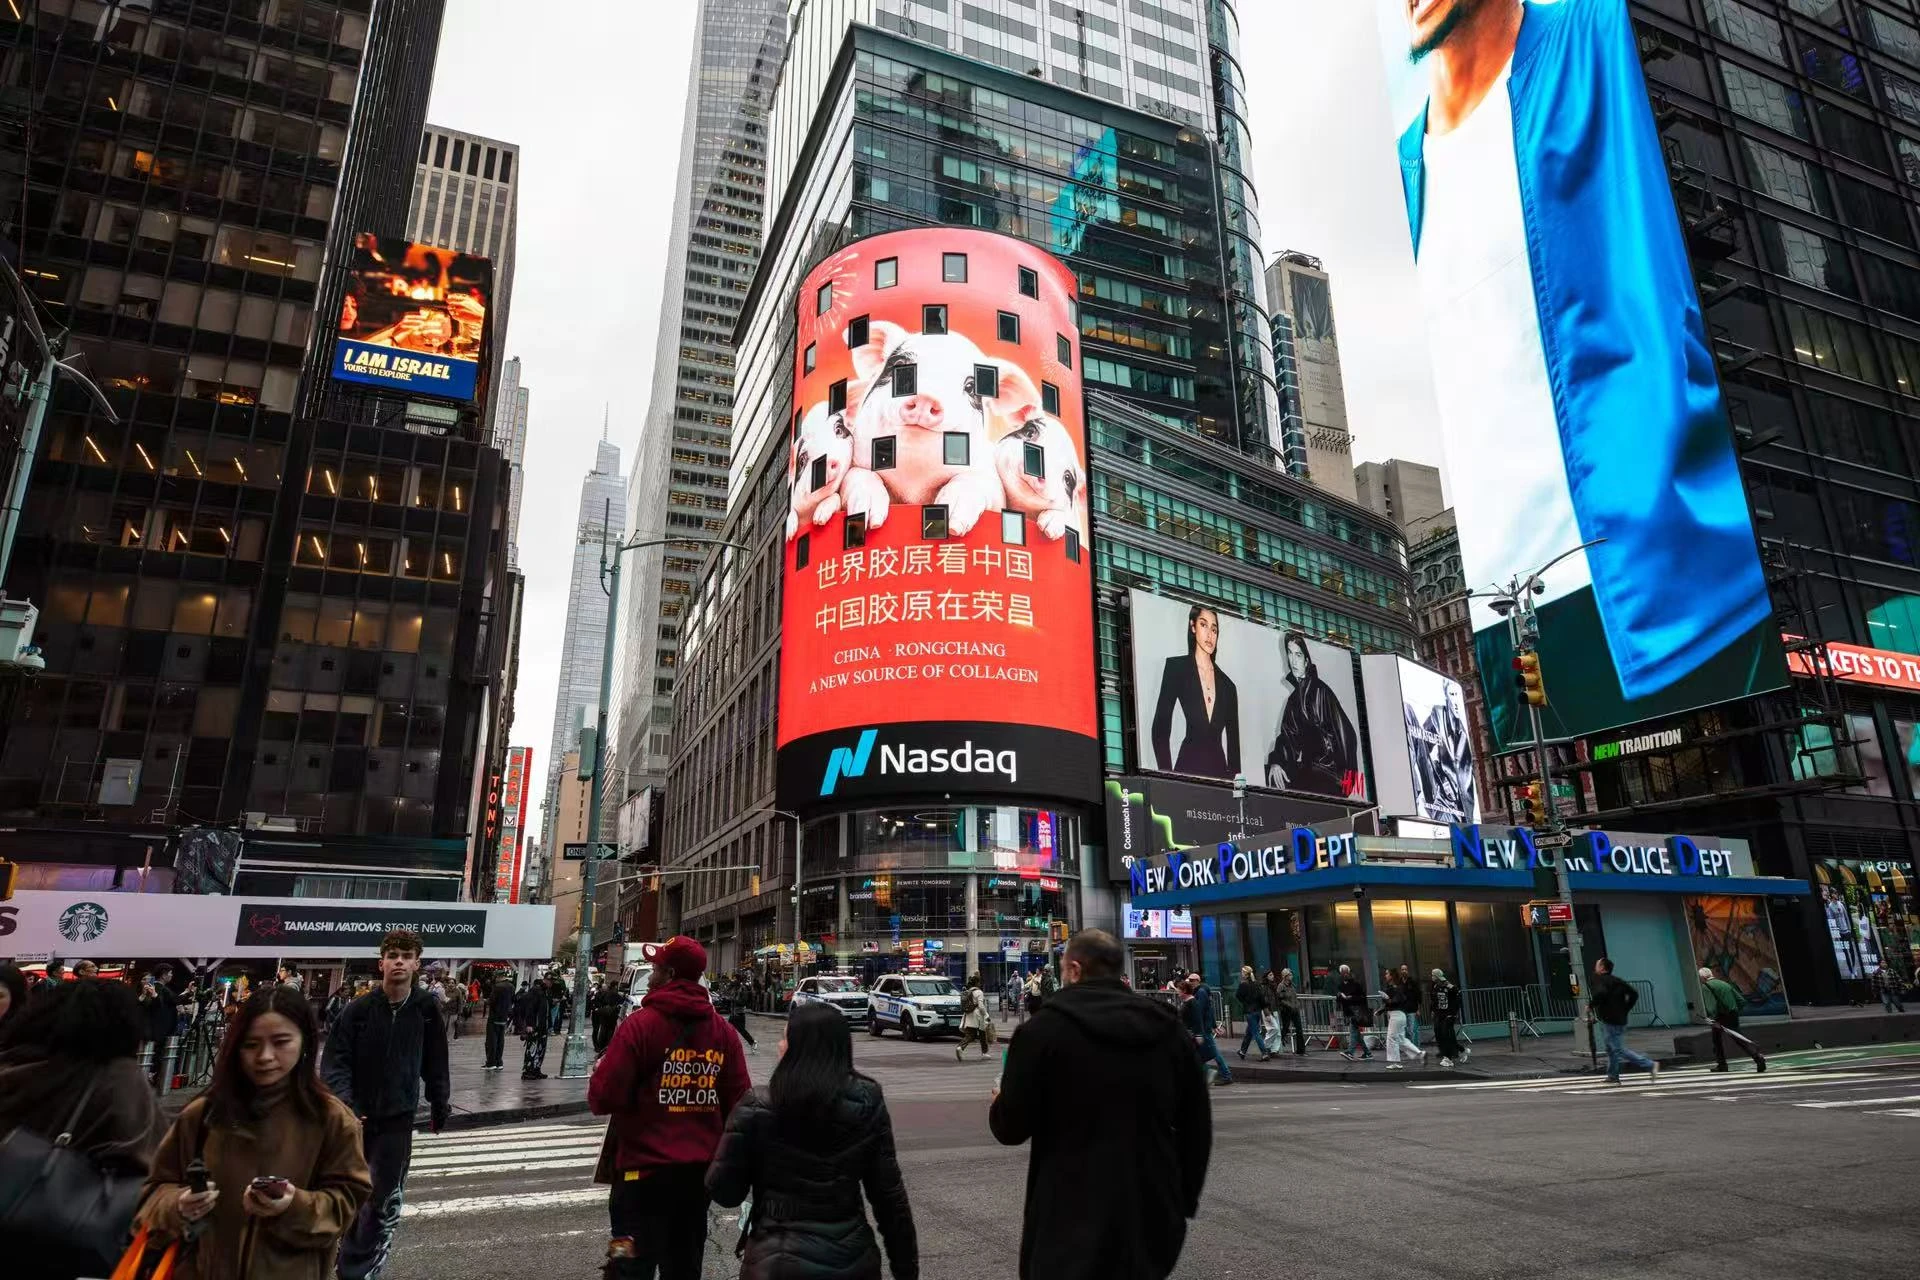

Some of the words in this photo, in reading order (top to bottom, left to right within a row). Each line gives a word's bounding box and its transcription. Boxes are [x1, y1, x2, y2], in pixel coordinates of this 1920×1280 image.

[344, 348, 353, 362] I
[355, 351, 388, 368] AM
[392, 356, 450, 380] ISRAEL
[344, 362, 367, 374] YOURS
[368, 367, 377, 375] TO
[379, 369, 412, 381] EXPLORE.
[816, 543, 1033, 589] 世界胶原看中国
[815, 588, 1033, 635] 中国胶原在荣昌
[834, 646, 881, 665] CHINA
[1873, 655, 1900, 679] TO
[809, 681, 818, 694] A
[820, 672, 850, 691] NEW
[853, 665, 918, 684] SOURCE
[922, 664, 945, 678] OF
[949, 664, 1039, 683] COLLAGEN
[880, 740, 1017, 783] Nasdaq
[486, 776, 500, 839] TONY
[1121, 788, 1129, 807] Labs
[1123, 808, 1132, 850] Cockroach
[1130, 858, 1166, 897] NEW
[1166, 852, 1215, 890] YORK
[1217, 842, 1286, 883] POLICE
[1292, 827, 1354, 872] DEPT
[1450, 823, 1516, 869] NEW
[1514, 827, 1590, 872] YO
[1588, 831, 1672, 874] POLICE
[1670, 835, 1733, 877] DEPT
[849, 892, 873, 900] branded
[284, 920, 334, 932] TAMASHII
[385, 923, 418, 934] STORE
[421, 923, 448, 934] NEW
[448, 923, 477, 935] YORK
[660, 1074, 717, 1088] HOP-OF
[663, 1061, 721, 1076] DISCOVR
[658, 1089, 720, 1105] EXPLOR
